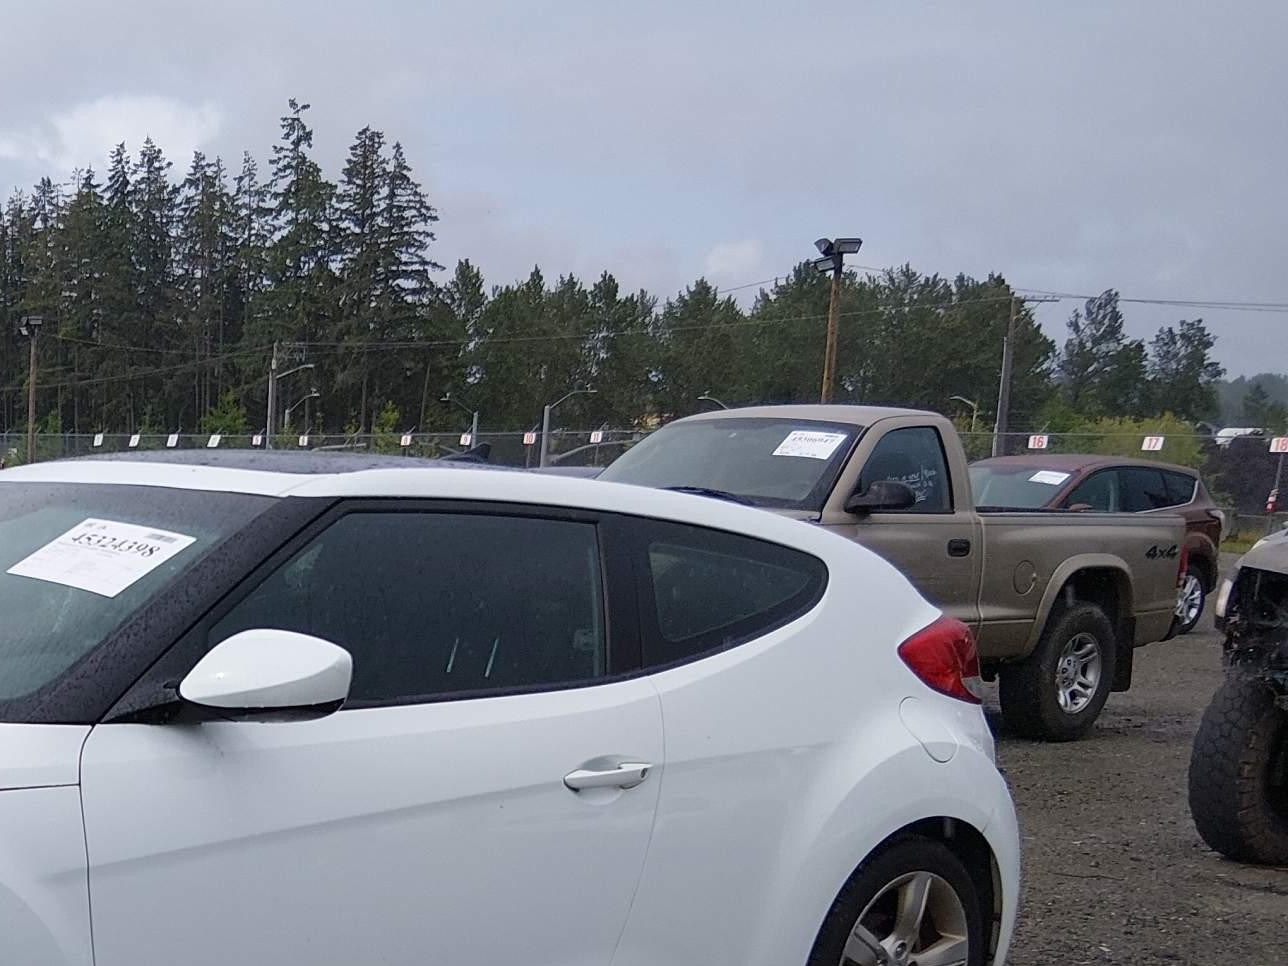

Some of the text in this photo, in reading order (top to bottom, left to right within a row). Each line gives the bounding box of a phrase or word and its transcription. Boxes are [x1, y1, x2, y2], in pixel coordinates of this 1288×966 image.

[1032, 436, 1044, 448] 16
[1148, 438, 1160, 449] 17
[1274, 438, 1288, 450] 18
[1144, 545, 1179, 559] 4x4
